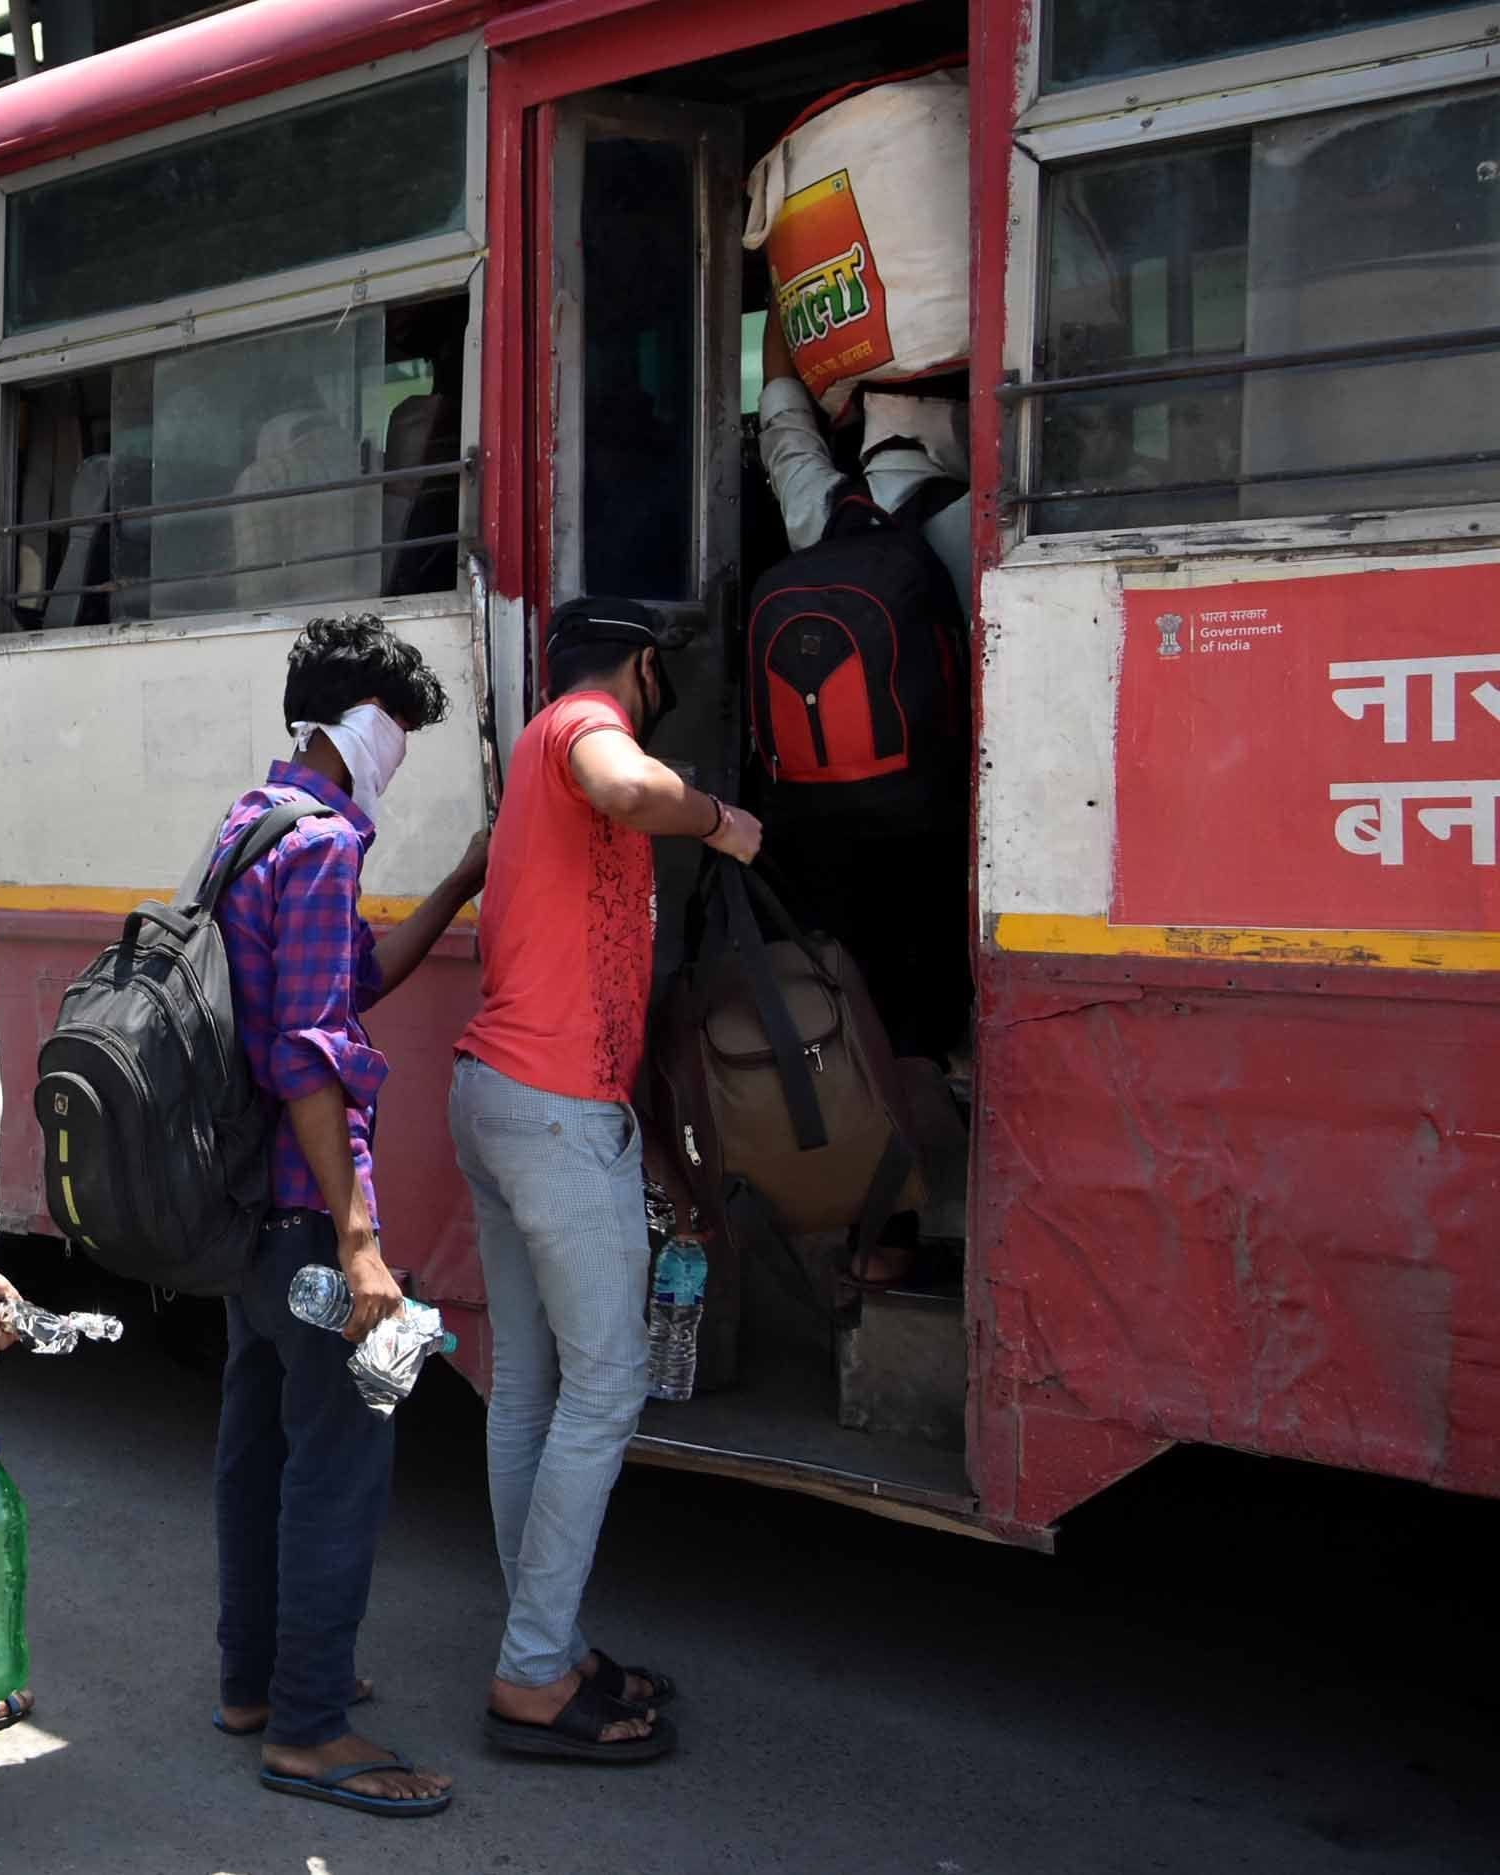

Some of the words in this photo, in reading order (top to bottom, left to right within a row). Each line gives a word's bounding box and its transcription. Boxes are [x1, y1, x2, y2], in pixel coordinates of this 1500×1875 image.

[1200, 611, 1227, 622] भारत
[1230, 609, 1268, 621] सरकार
[1200, 623, 1283, 638] Government
[1200, 641, 1215, 653] of
[1217, 640, 1250, 652] India
